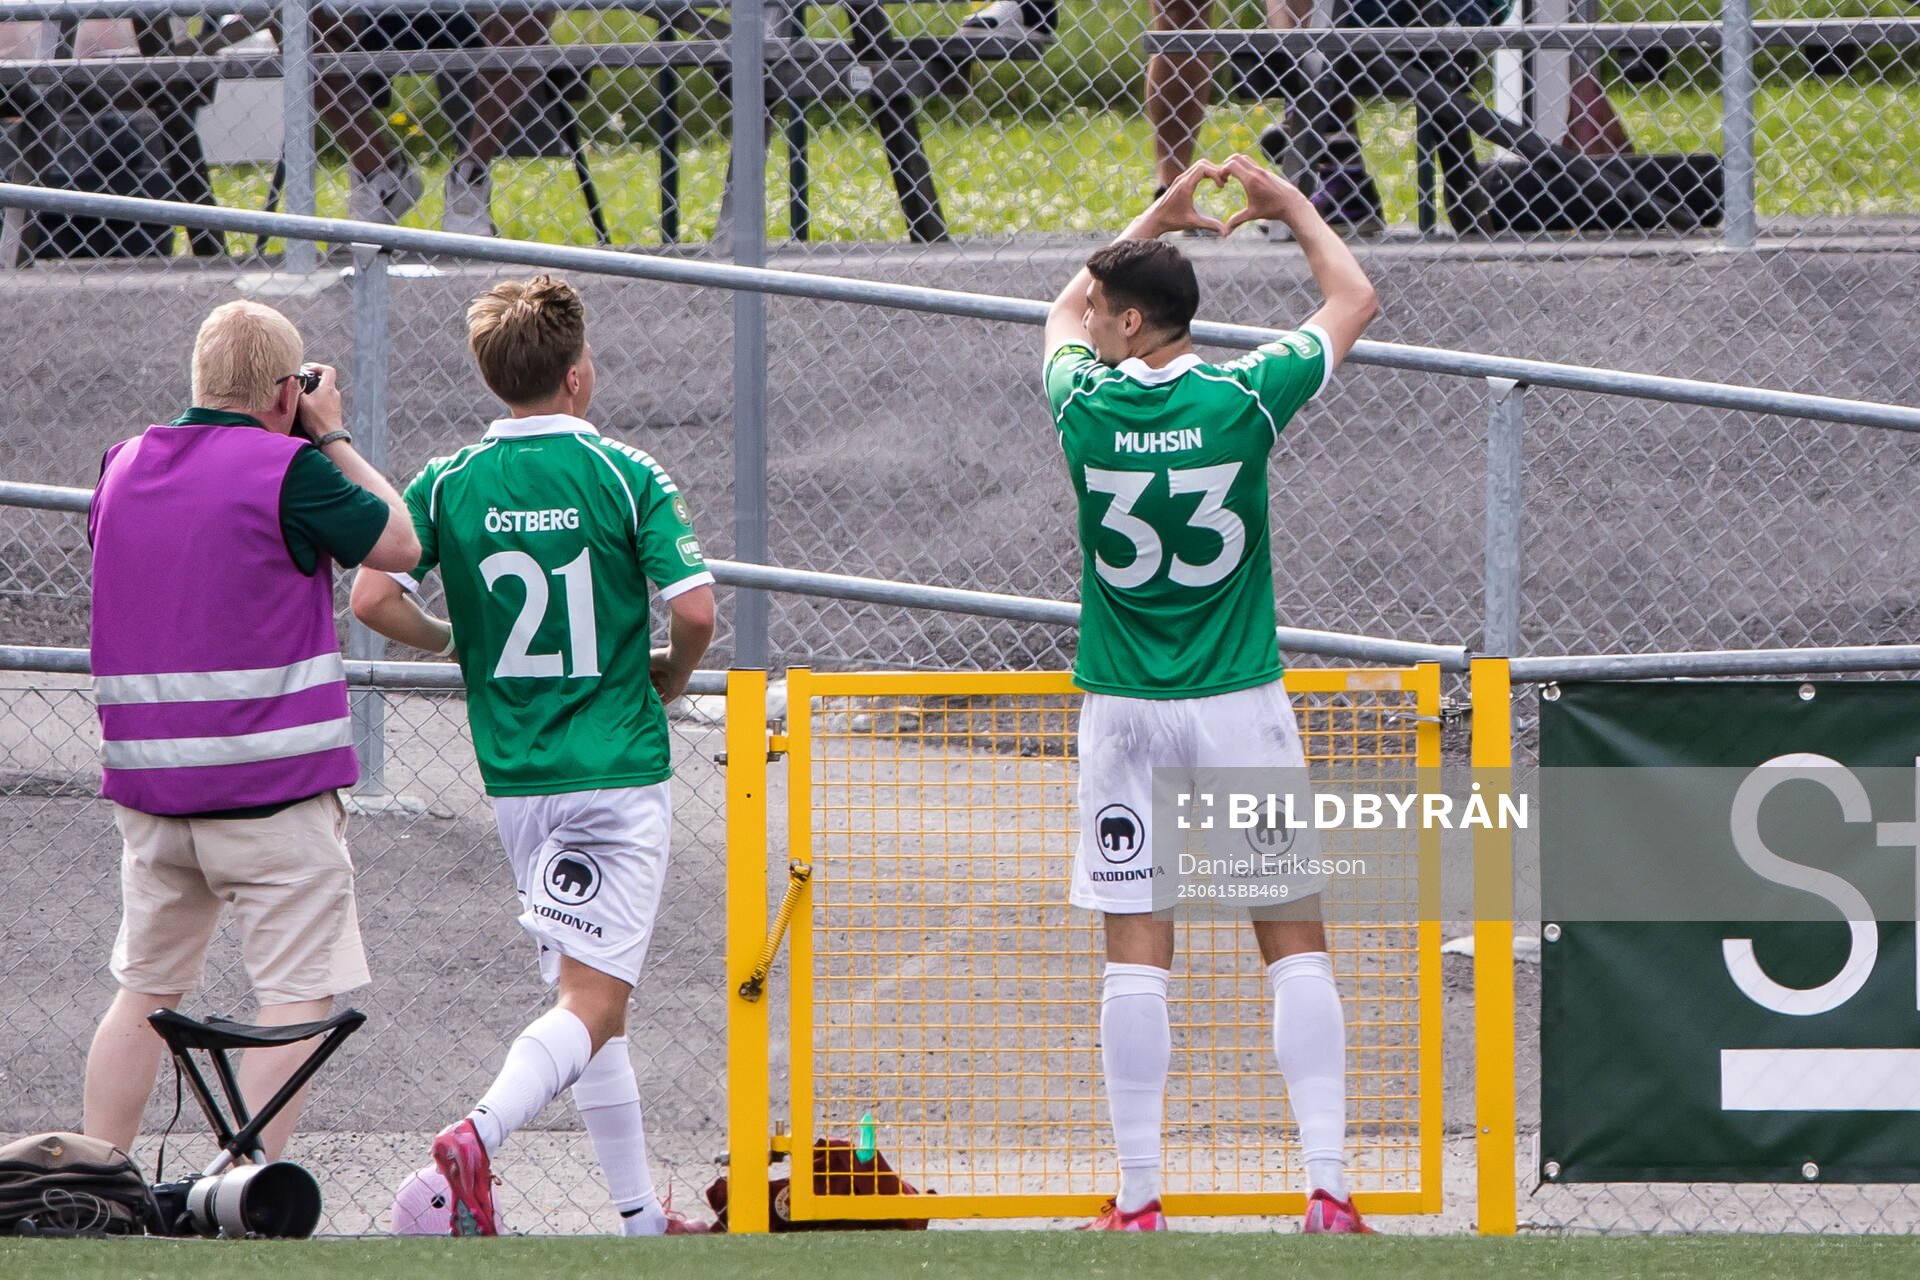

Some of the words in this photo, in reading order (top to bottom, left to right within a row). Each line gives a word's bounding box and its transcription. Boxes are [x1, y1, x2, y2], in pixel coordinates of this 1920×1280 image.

[1114, 427, 1203, 453] MUHSIN
[484, 507, 580, 533] ÖSTBERG
[1084, 461, 1246, 588] 33
[478, 547, 602, 678] 21
